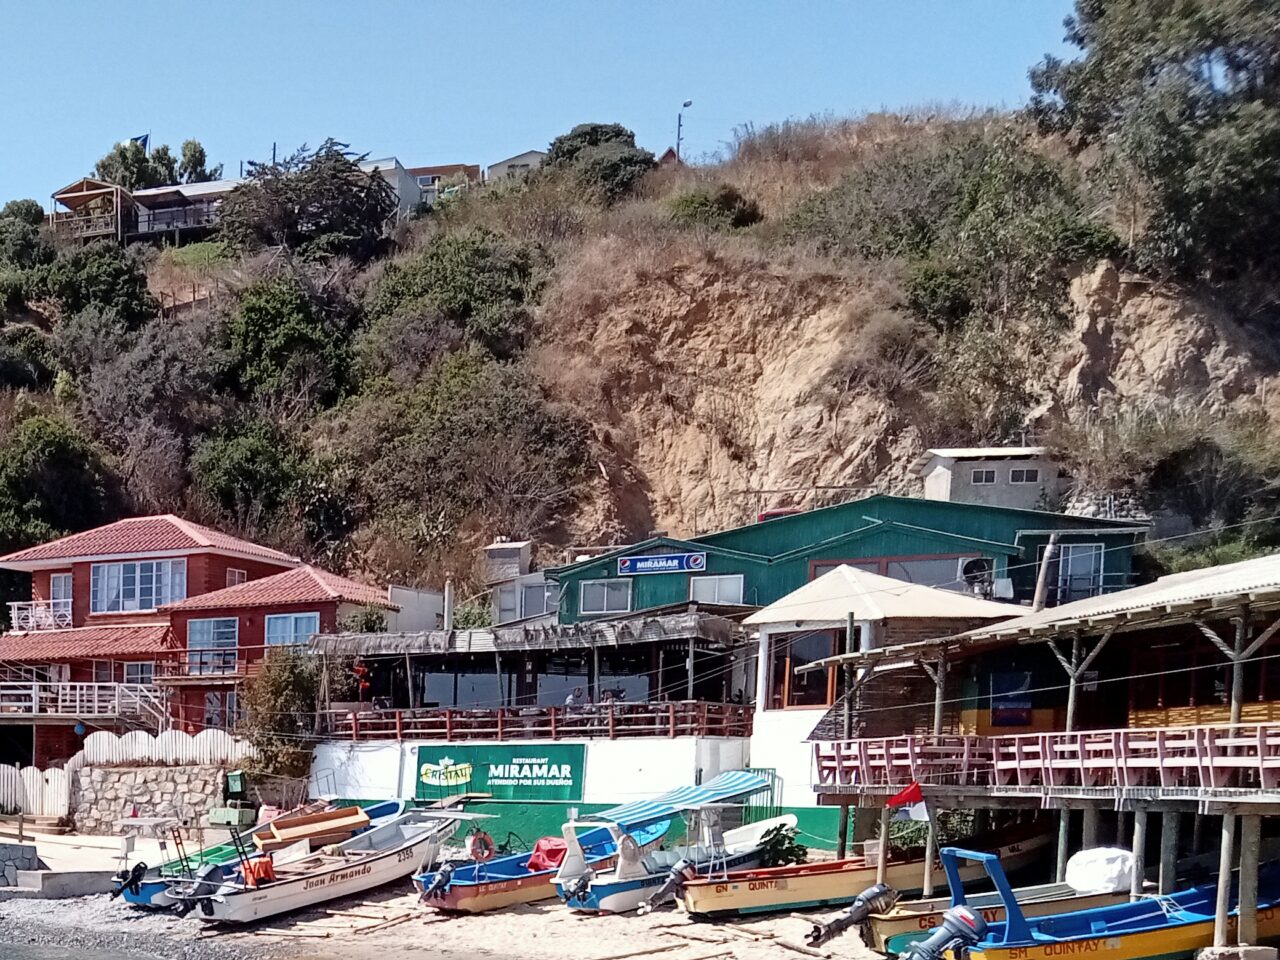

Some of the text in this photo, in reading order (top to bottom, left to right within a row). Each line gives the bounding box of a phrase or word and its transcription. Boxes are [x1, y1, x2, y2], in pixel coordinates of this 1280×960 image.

[637, 560, 679, 569] MIRAMAR
[488, 764, 572, 778] MIRAMAR
[397, 851, 414, 863] 2355
[303, 865, 372, 891] Juan Armando
[716, 880, 778, 893] GN QUINT
[919, 916, 937, 929] CS
[1009, 940, 1100, 959] SM QUINTAY
